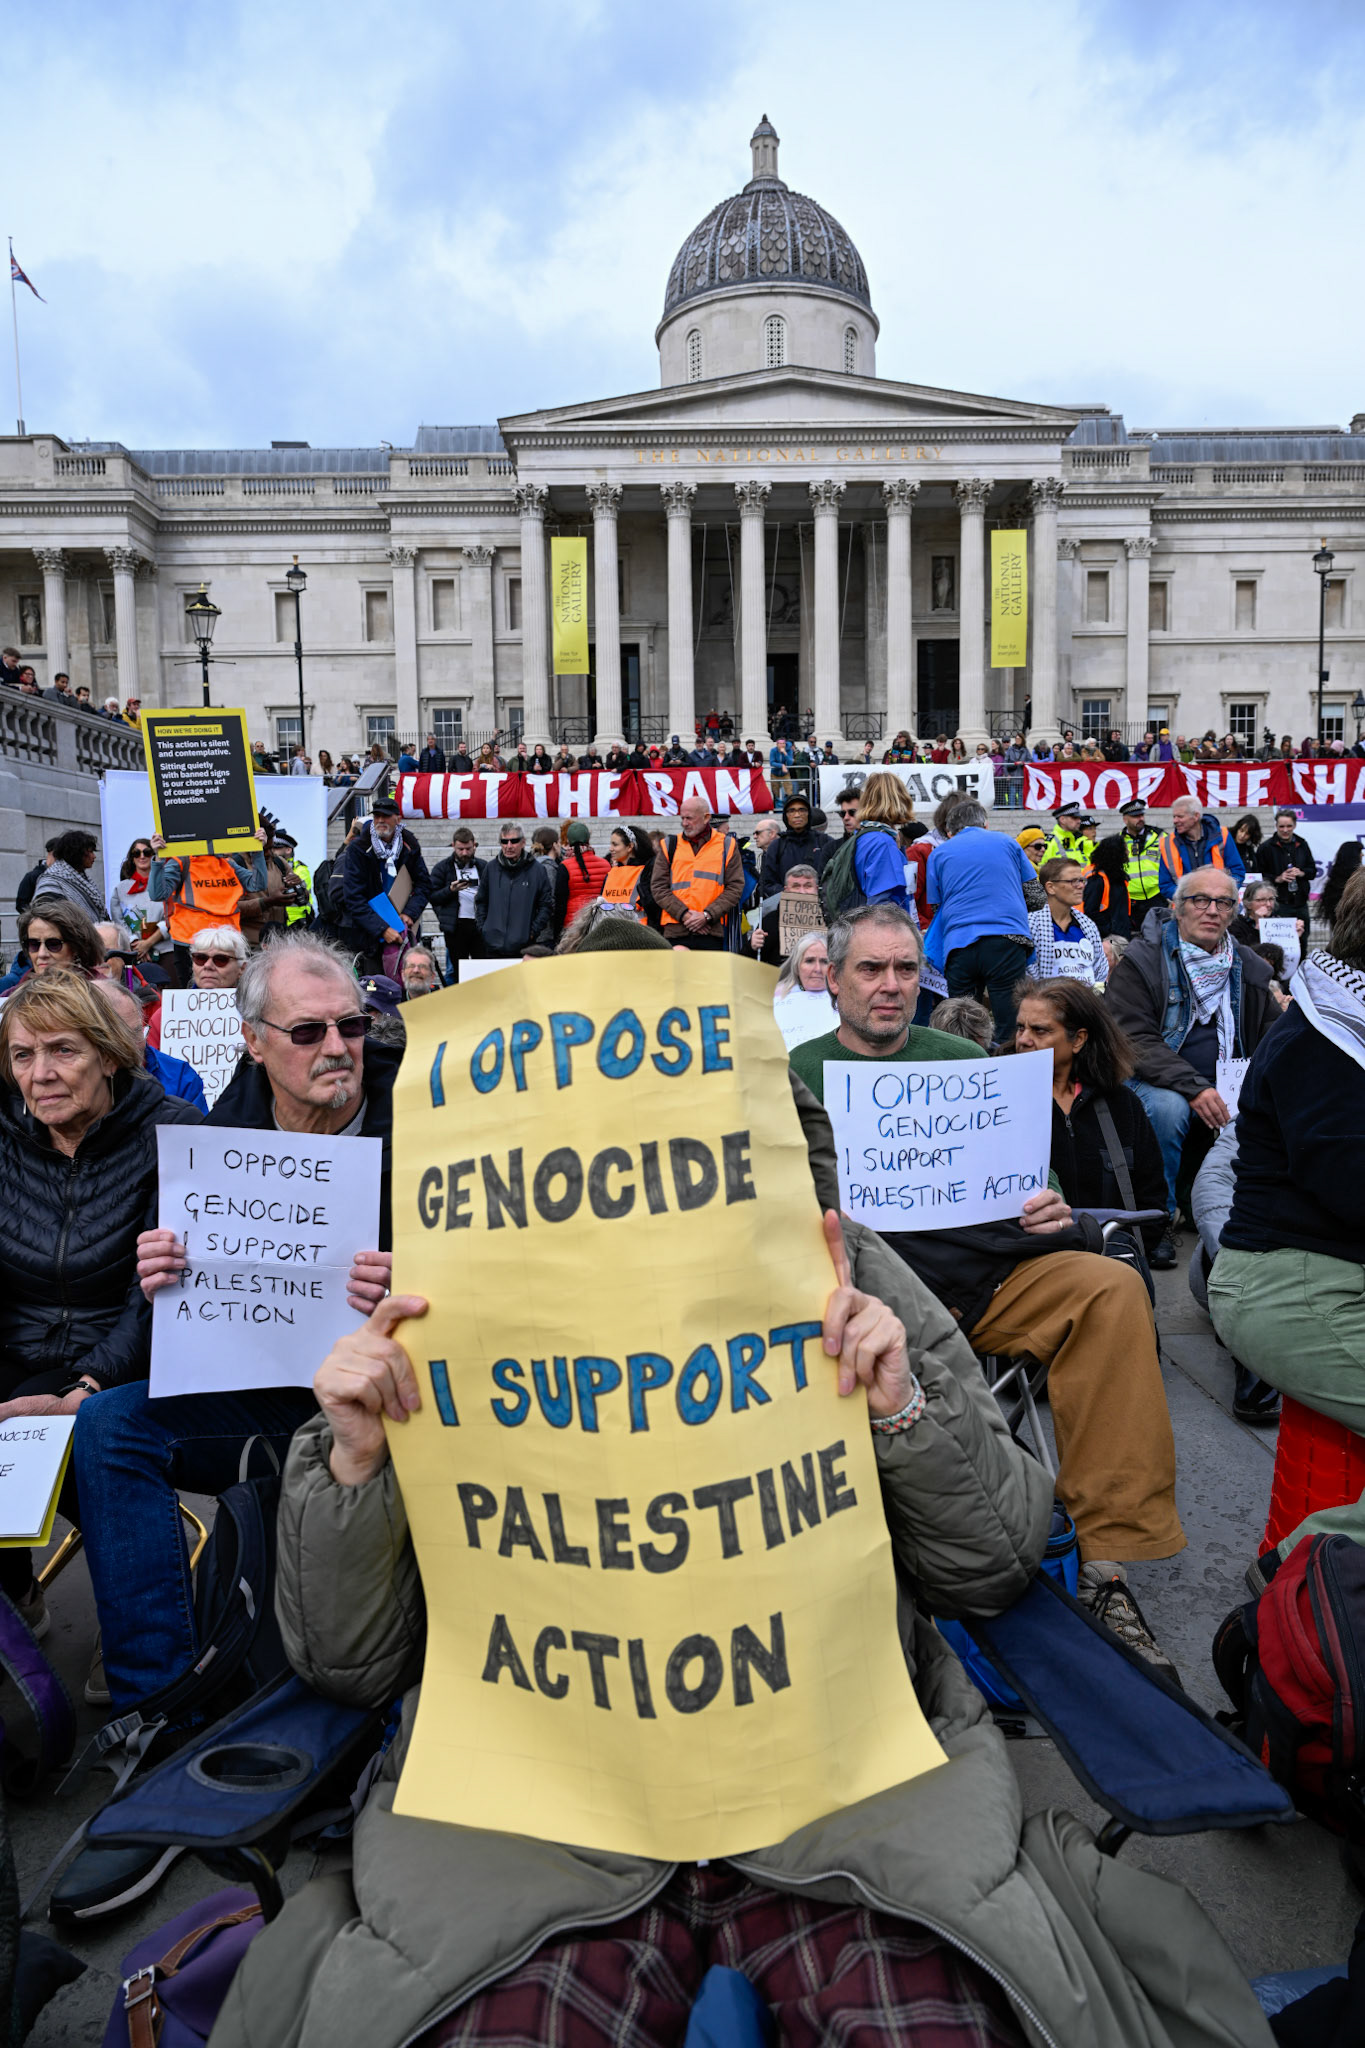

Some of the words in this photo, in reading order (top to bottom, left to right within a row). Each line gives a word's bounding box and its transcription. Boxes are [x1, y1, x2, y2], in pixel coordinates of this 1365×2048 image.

[635, 449, 680, 463] THE
[696, 448, 819, 463] NATIONAL
[836, 446, 944, 460] GALLERY
[561, 561, 570, 623] NATIONAL
[571, 561, 582, 623] GALLERY
[1001, 553, 1010, 615] NATIONAL
[1011, 553, 1022, 615] GALLERY
[157, 741, 174, 749] This
[200, 740, 207, 748] is
[174, 748, 231, 757] contemplative.
[160, 763, 187, 771] Sitting
[187, 761, 214, 770] quietly
[161, 771, 179, 779] with
[180, 770, 209, 778] banned
[210, 769, 230, 778] signs
[162, 780, 170, 788] is
[185, 779, 213, 787] chosen
[173, 788, 204, 796] courage
[402, 773, 508, 818] LIFT
[526, 773, 622, 818] THE
[643, 769, 753, 817] BAN
[842, 771, 980, 802] PACE
[1025, 764, 1166, 811] DROP
[1178, 764, 1271, 808] THE
[165, 797, 207, 806] protection.
[785, 900, 789, 912] I
[795, 901, 823, 915] OPPO
[1054, 948, 1092, 962] DOCTOR
[171, 994, 175, 1012] I
[187, 992, 237, 1012] OPPOS
[163, 1017, 240, 1039] GENOCID
[181, 1043, 246, 1065] SUPPO
[429, 1041, 448, 1108] I
[470, 1004, 733, 1095] OPPOSE
[846, 1073, 851, 1113] I
[872, 1068, 1002, 1109] OPPOSE
[877, 1105, 1012, 1139] GENOCIDE
[189, 1147, 194, 1170] I
[223, 1149, 333, 1182] OPPOSE
[845, 1147, 850, 1175] I
[863, 1145, 965, 1172] SUPPORT
[418, 1130, 757, 1232] GENOCIDE
[849, 1180, 967, 1210] PALESTINE
[983, 1166, 1045, 1201] ACTION
[184, 1192, 330, 1225] GENOCIDE
[183, 1230, 189, 1249] I
[206, 1232, 328, 1263] SUPPORT
[179, 1267, 324, 1299] PALESTINE
[176, 1300, 295, 1325] ACTION
[428, 1358, 460, 1427] I
[490, 1320, 824, 1434] SUPPORT
[456, 1439, 858, 1574] PALESTINE
[481, 1611, 792, 1719] ACTION
